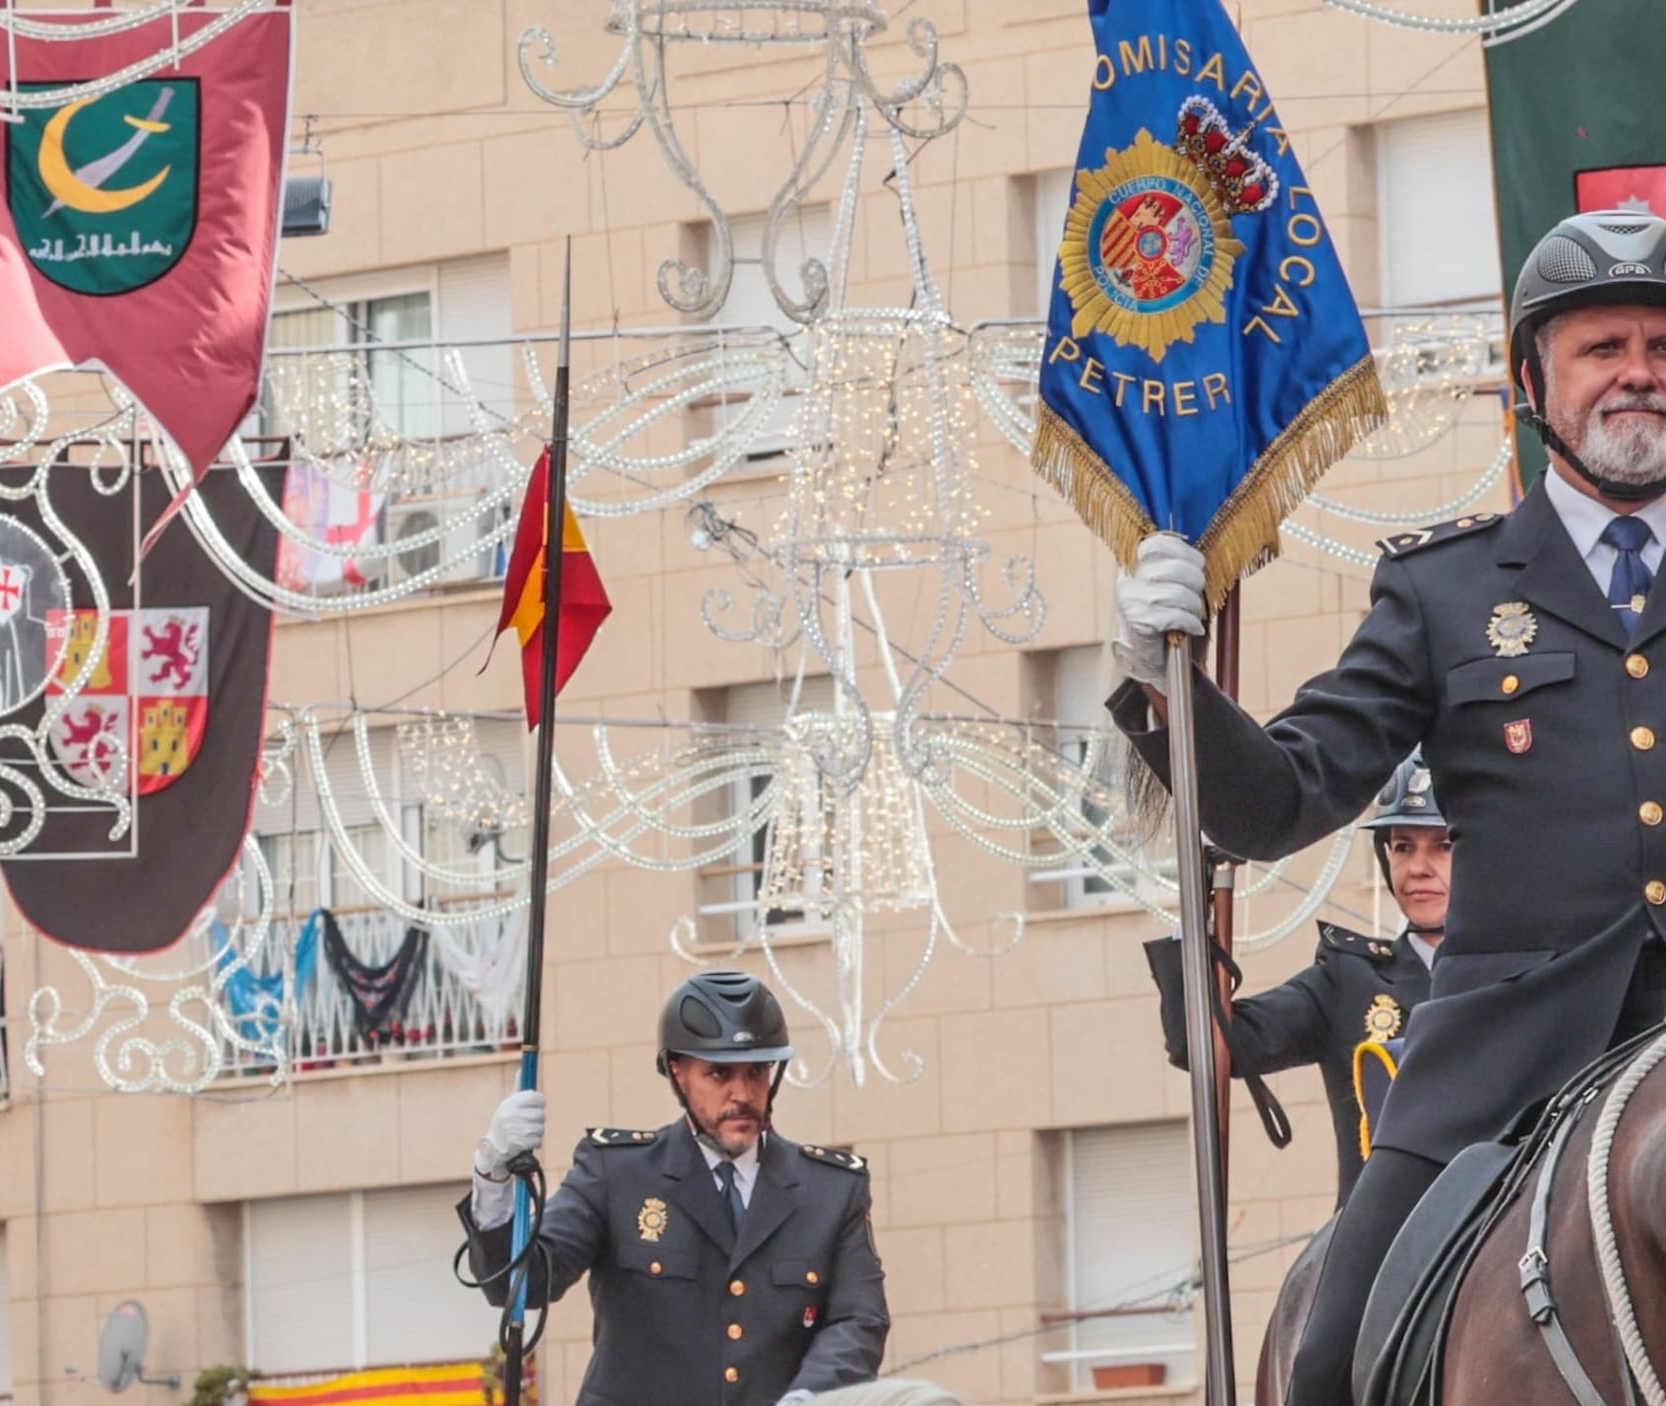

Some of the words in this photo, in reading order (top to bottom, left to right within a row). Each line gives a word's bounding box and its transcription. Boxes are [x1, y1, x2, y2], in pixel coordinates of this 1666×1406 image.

[1092, 34, 1291, 156] OMISARIA
[1242, 186, 1321, 344] LOCAL
[1109, 178, 1166, 204] CUERPO
[1173, 183, 1214, 257] NACIONAL
[1048, 336, 1232, 417] PETRER
